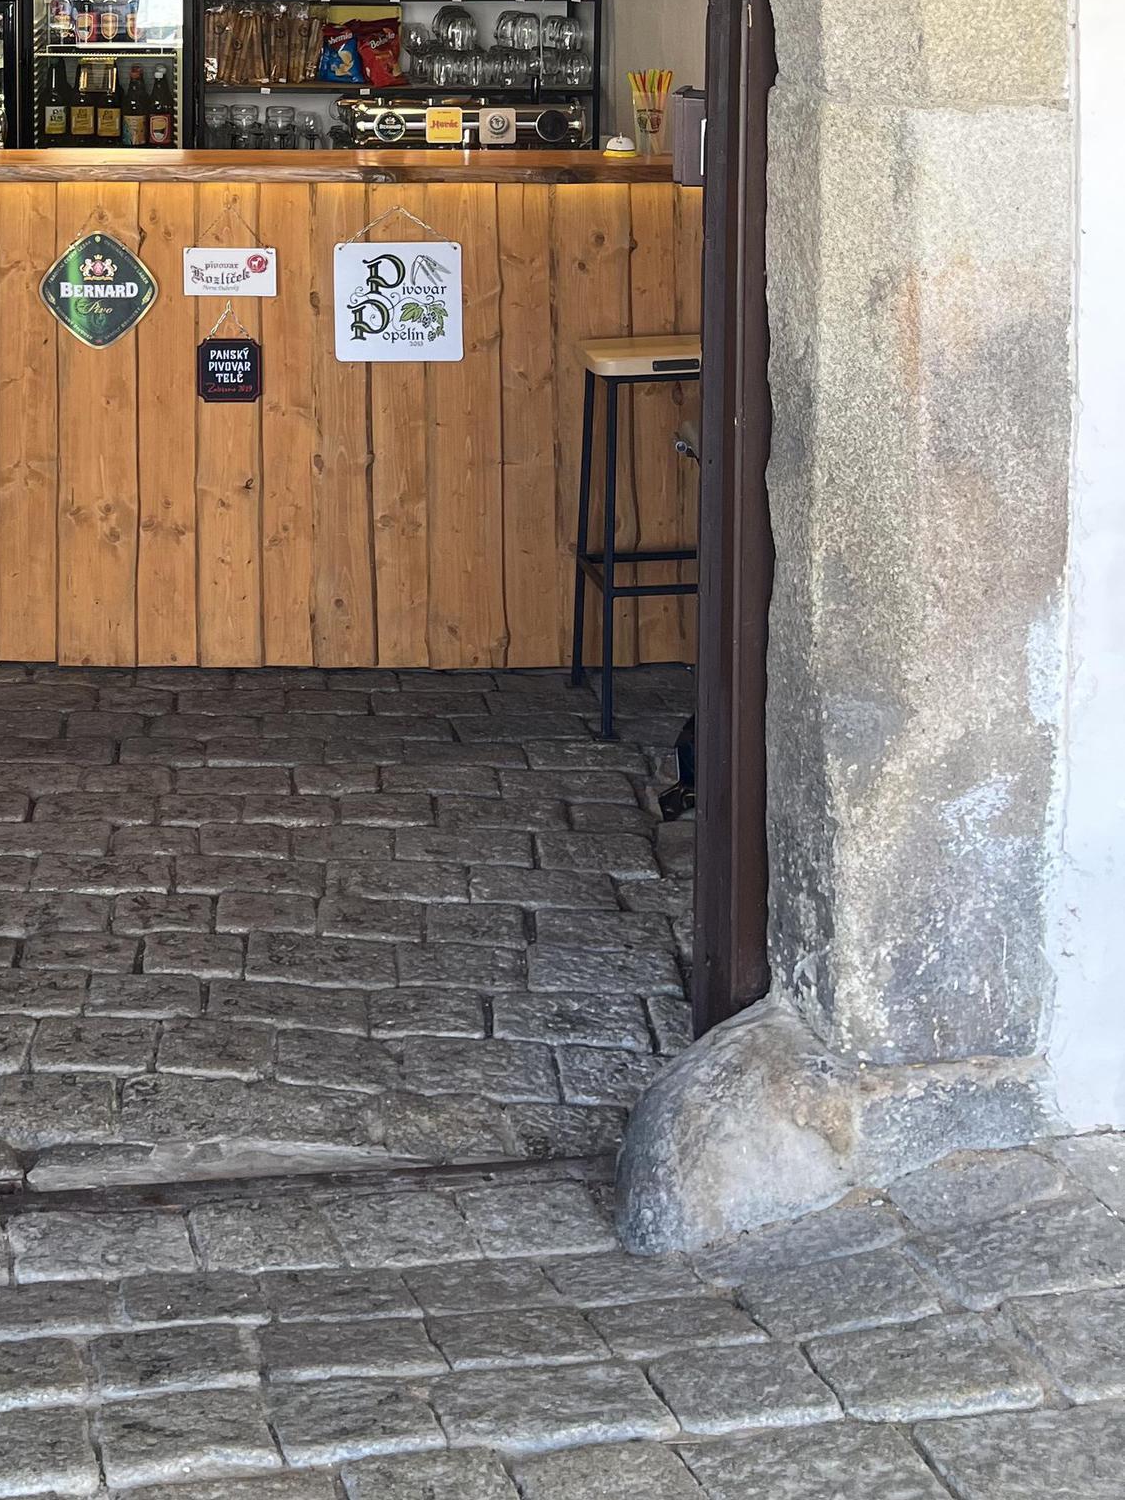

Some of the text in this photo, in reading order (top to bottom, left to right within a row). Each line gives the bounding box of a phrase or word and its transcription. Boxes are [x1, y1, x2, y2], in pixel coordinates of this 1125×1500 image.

[430, 120, 459, 130] Horác
[205, 261, 239, 269] pivovar
[190, 265, 250, 284] Kozlíček
[363, 254, 447, 295] Pivovar
[60, 282, 139, 298] BERNARD
[85, 299, 113, 314] Pivo
[347, 299, 424, 343] Popelín
[210, 347, 249, 360] PANSKÝ
[208, 362, 251, 371] PIVOVAR
[215, 371, 243, 383] TELČ
